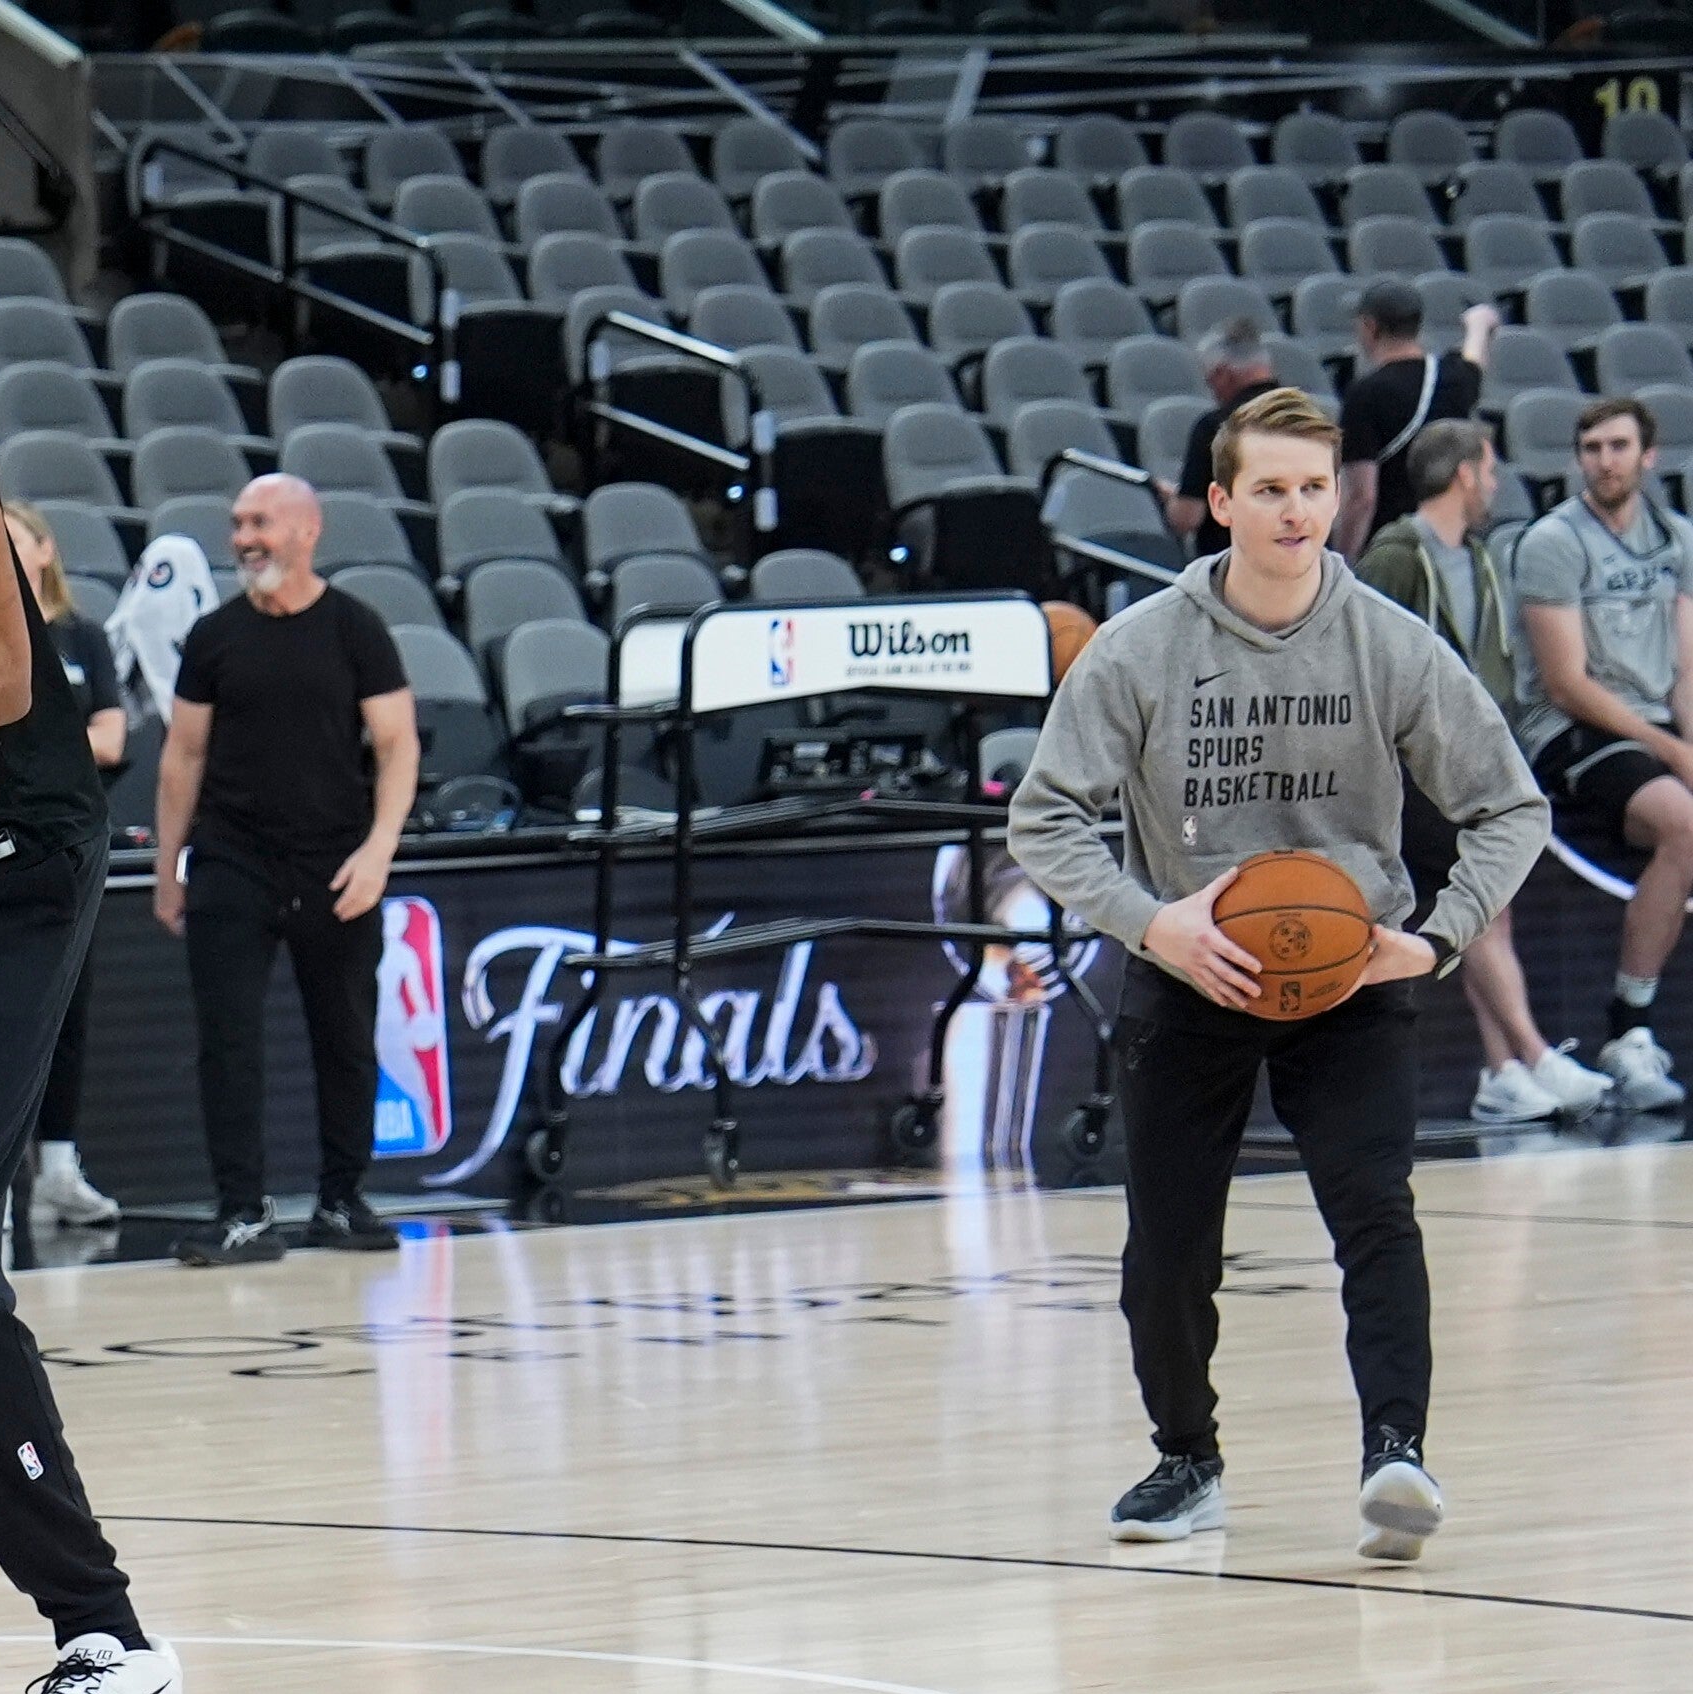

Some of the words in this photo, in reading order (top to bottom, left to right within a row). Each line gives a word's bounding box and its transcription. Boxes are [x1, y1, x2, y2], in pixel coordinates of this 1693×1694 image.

[848, 618, 972, 658] Wilson
[1189, 697, 1234, 729] SAN
[1246, 693, 1353, 727] ANTONIO
[1187, 735, 1264, 769] SPURS
[1183, 770, 1340, 808] BASKETBALL
[420, 911, 879, 1188] Finals
